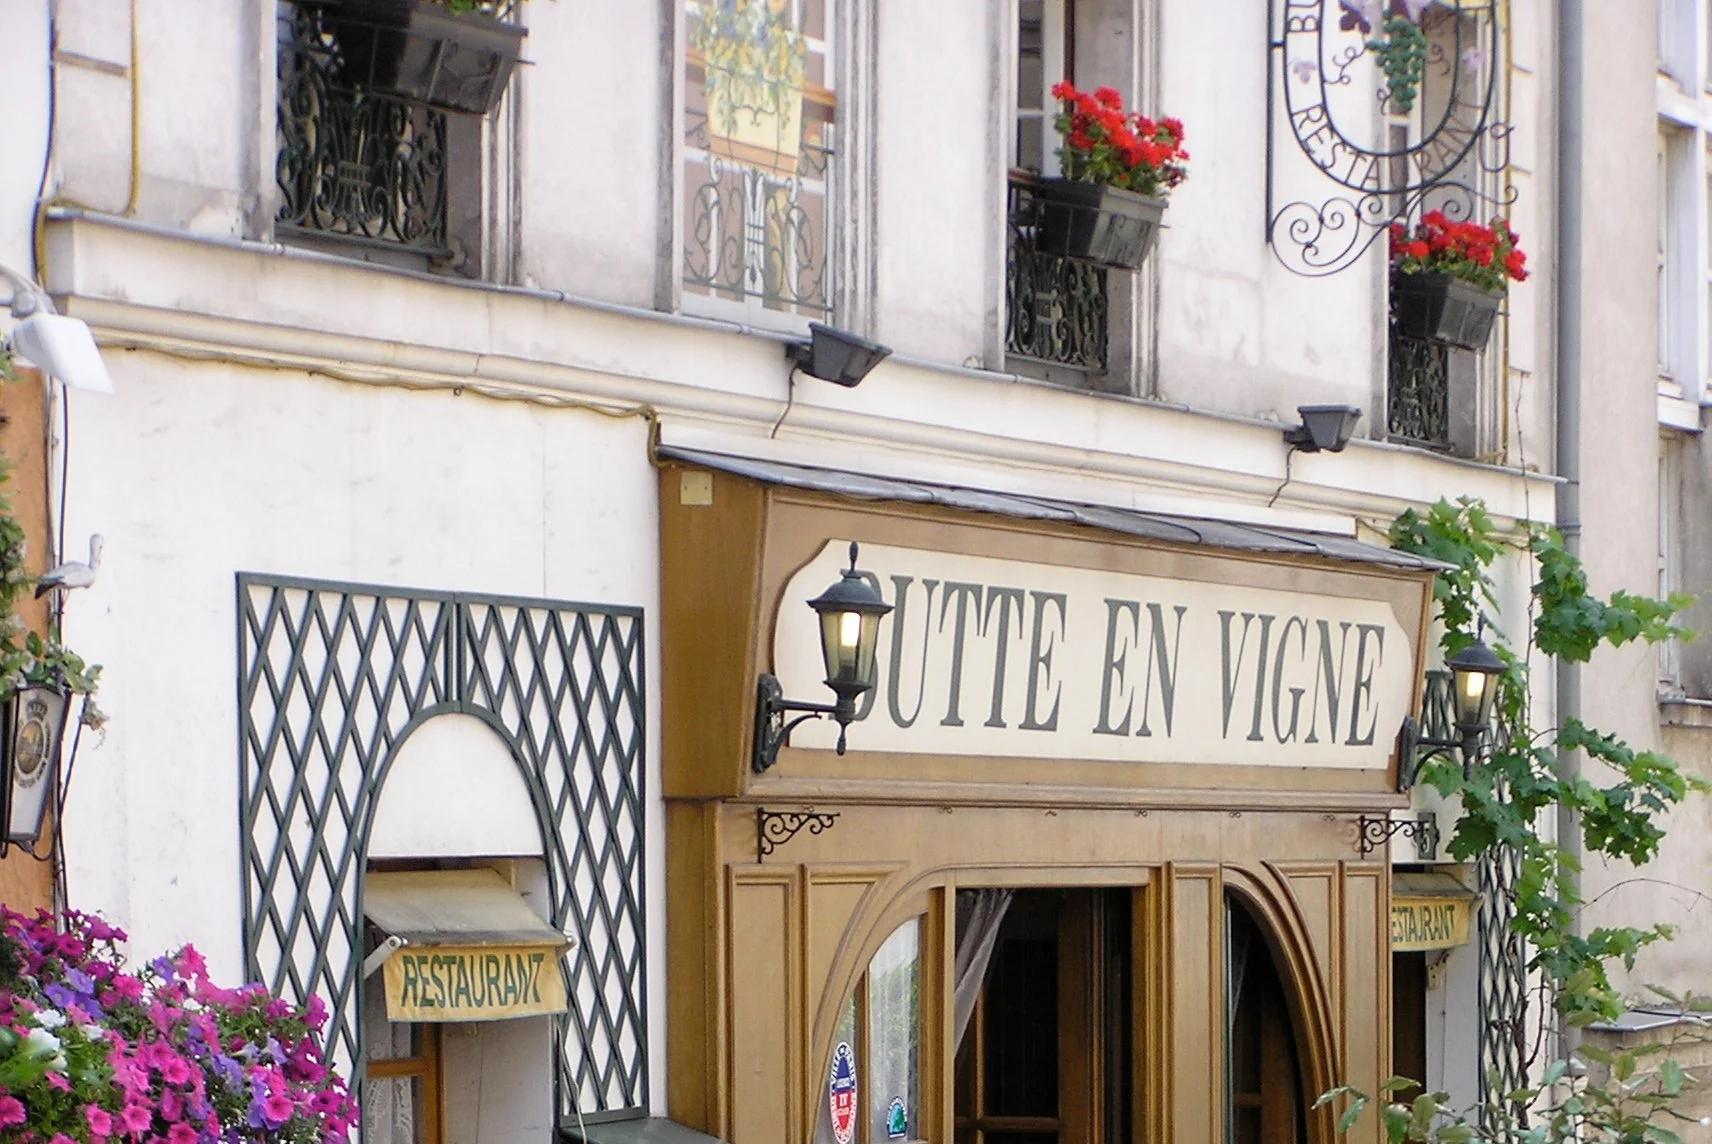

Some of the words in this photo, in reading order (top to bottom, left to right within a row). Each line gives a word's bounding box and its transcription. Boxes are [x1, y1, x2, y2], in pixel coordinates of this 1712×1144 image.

[1290, 95, 1485, 190] RESTAURANT
[1092, 597, 1188, 738] EN
[1217, 609, 1385, 746] VIGNE
[1391, 903, 1456, 943] ESTAURANT
[401, 952, 545, 1009] RESTAURANT
